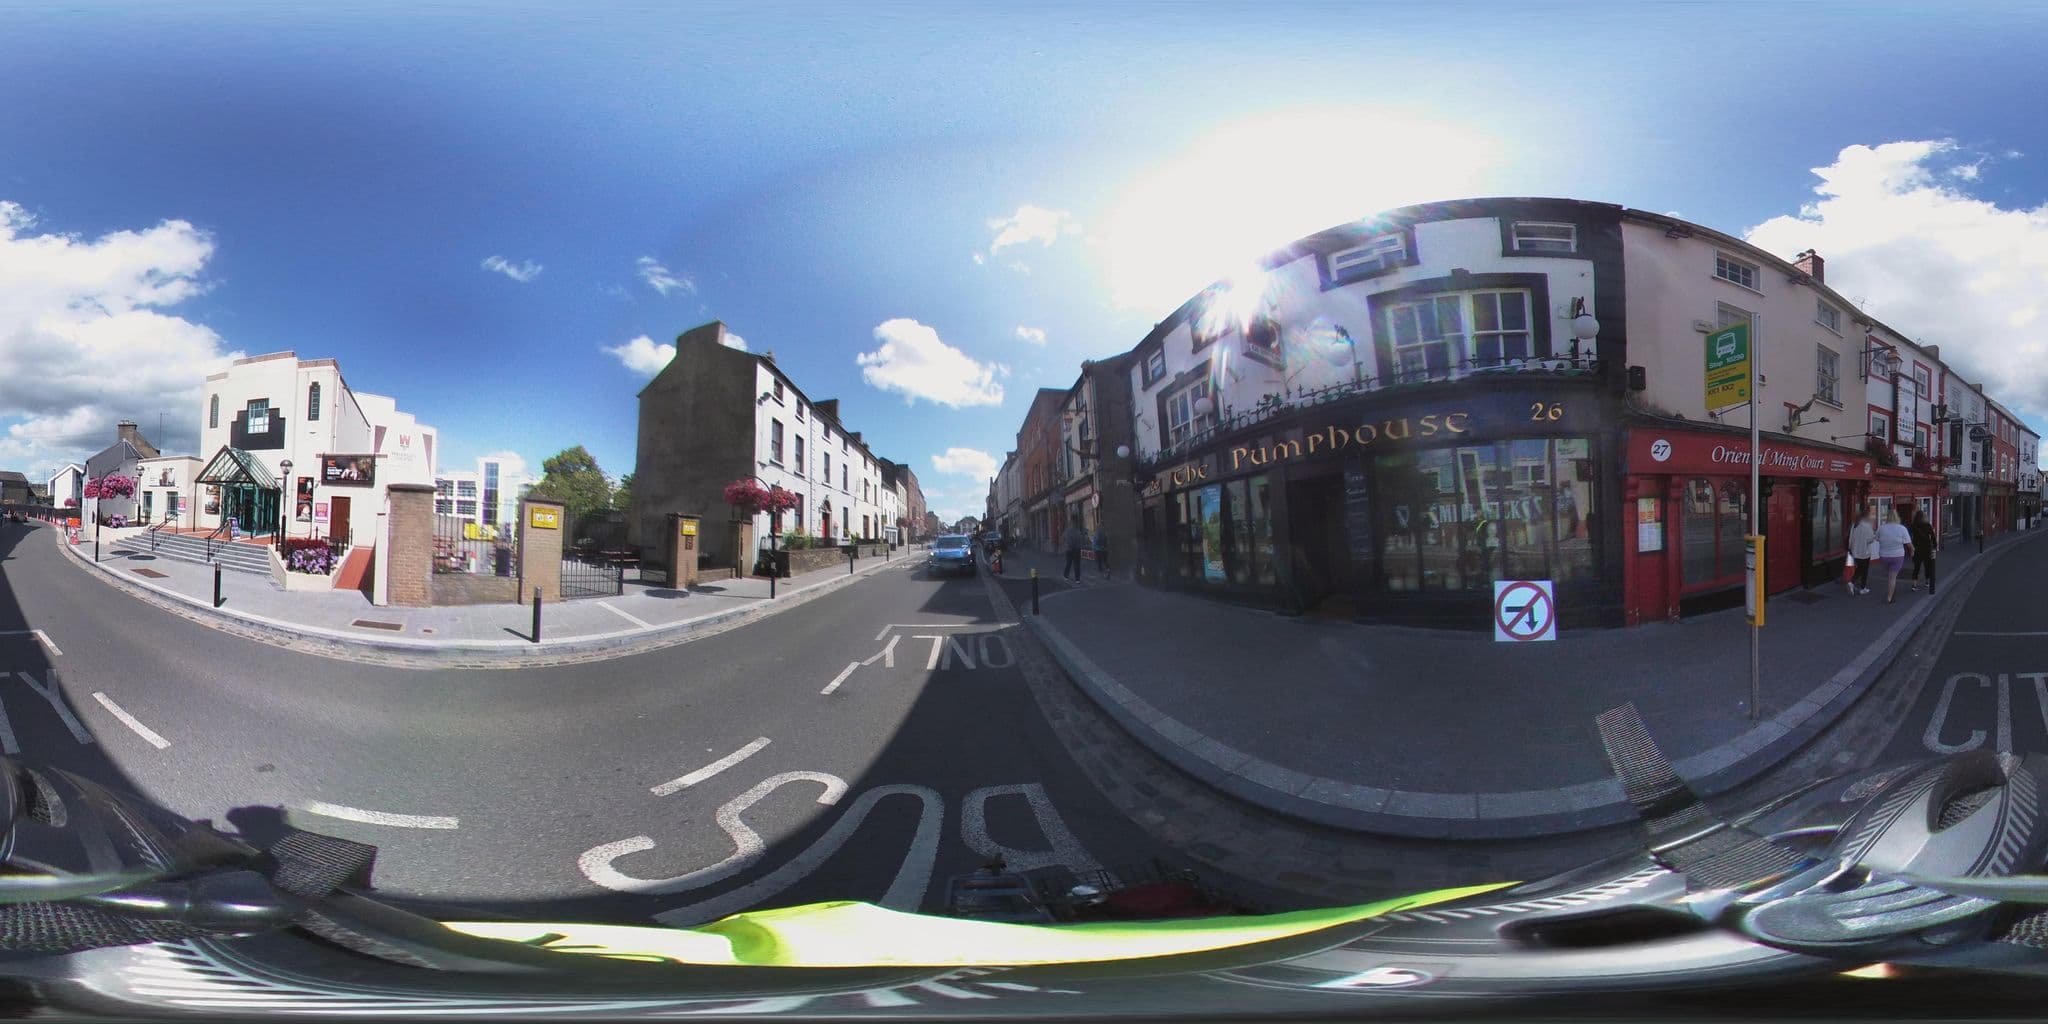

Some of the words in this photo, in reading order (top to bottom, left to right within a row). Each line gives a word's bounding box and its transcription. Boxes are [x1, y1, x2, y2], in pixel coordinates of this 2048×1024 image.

[1531, 402, 1563, 421] 26
[1653, 444, 1668, 456] 27
[1711, 445, 1771, 465] Orienal
[1769, 451, 1799, 470] Ming
[1800, 454, 1825, 469] Court
[1174, 464, 1208, 485] The
[861, 634, 1016, 670] ONLY
